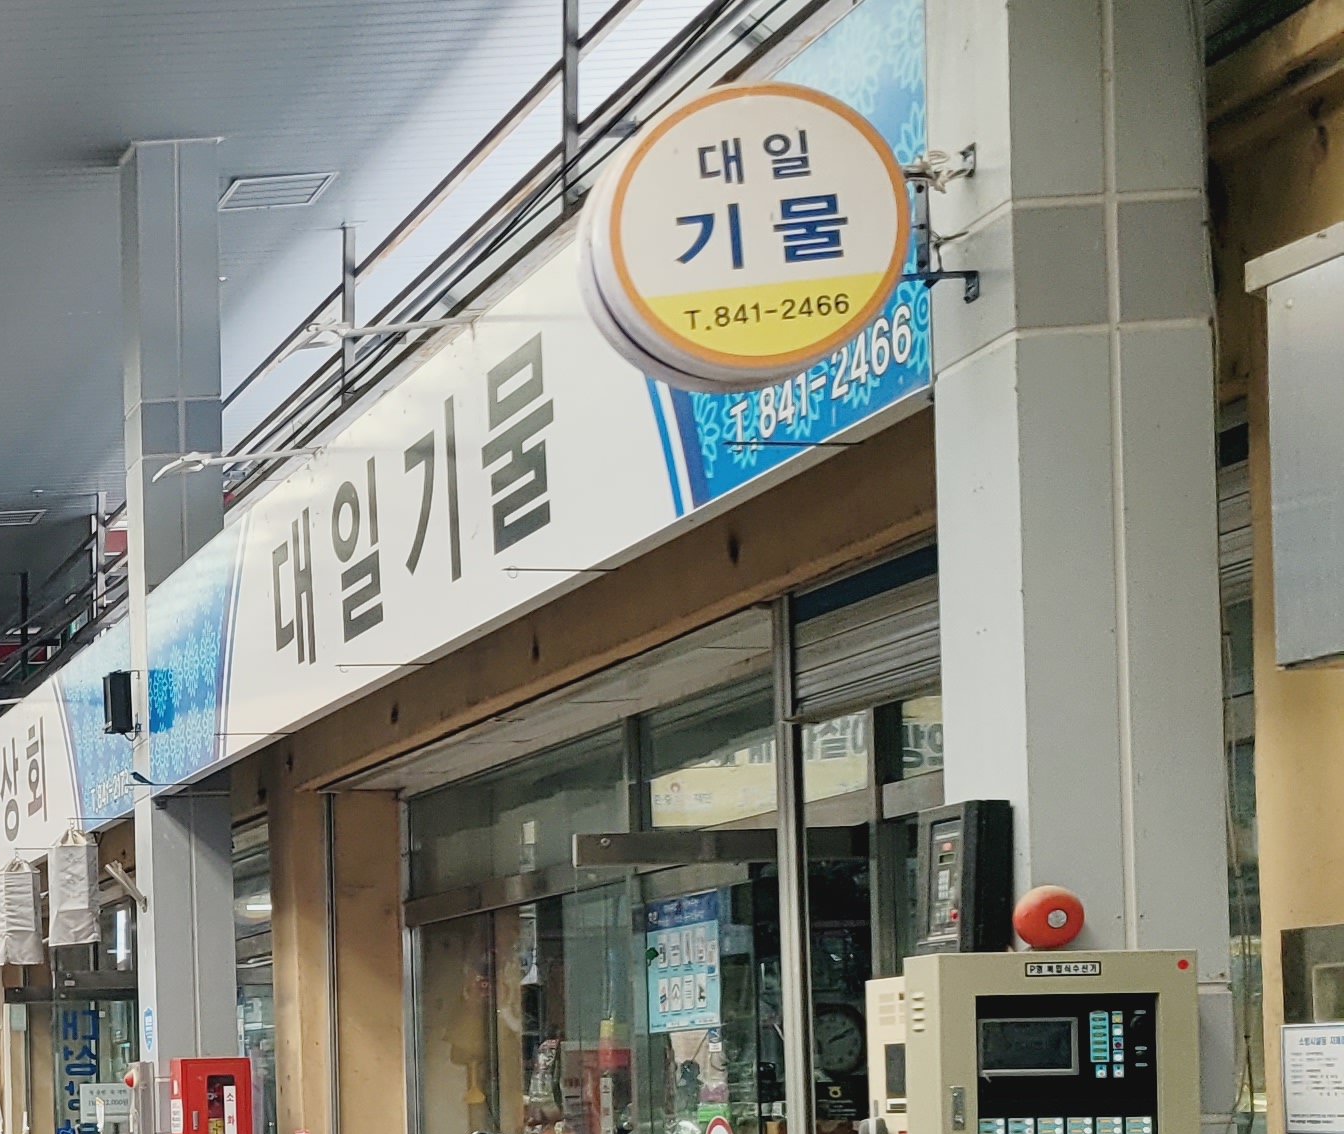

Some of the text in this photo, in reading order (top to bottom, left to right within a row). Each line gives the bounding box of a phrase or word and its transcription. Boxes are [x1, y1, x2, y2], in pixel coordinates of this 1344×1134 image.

[697, 129, 812, 185] 대일
[676, 193, 849, 270] 기물
[684, 293, 850, 331] T.841-2466
[729, 304, 912, 452] T.841-2466
[272, 331, 554, 666] 대일기물
